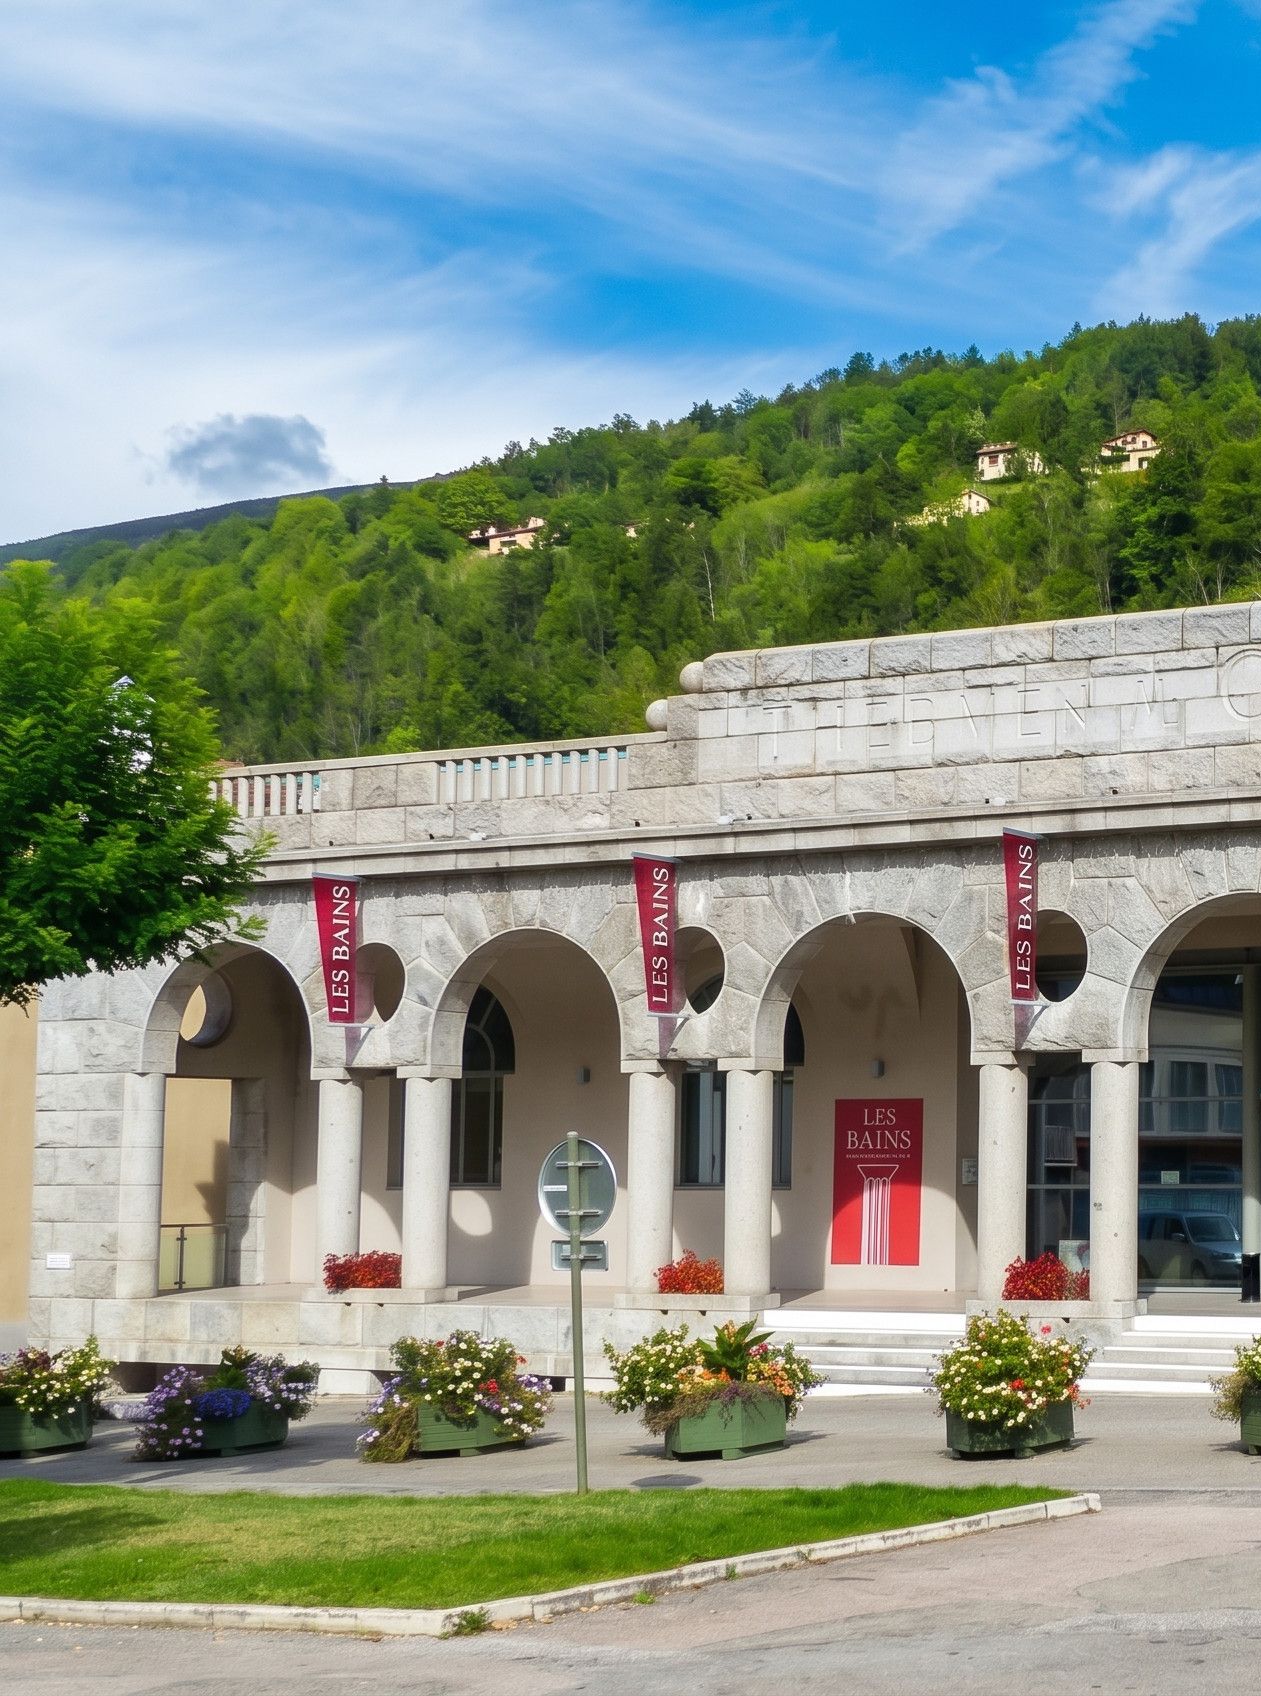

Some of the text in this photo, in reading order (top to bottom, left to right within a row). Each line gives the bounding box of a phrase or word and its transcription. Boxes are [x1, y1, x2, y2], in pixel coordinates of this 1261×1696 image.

[332, 884, 350, 1014] LES BAINS
[652, 866, 669, 1005] LES BAINS
[1016, 844, 1033, 991] LES BAINS
[846, 1130, 911, 1150] BAINS
[863, 1108, 896, 1126] LES
